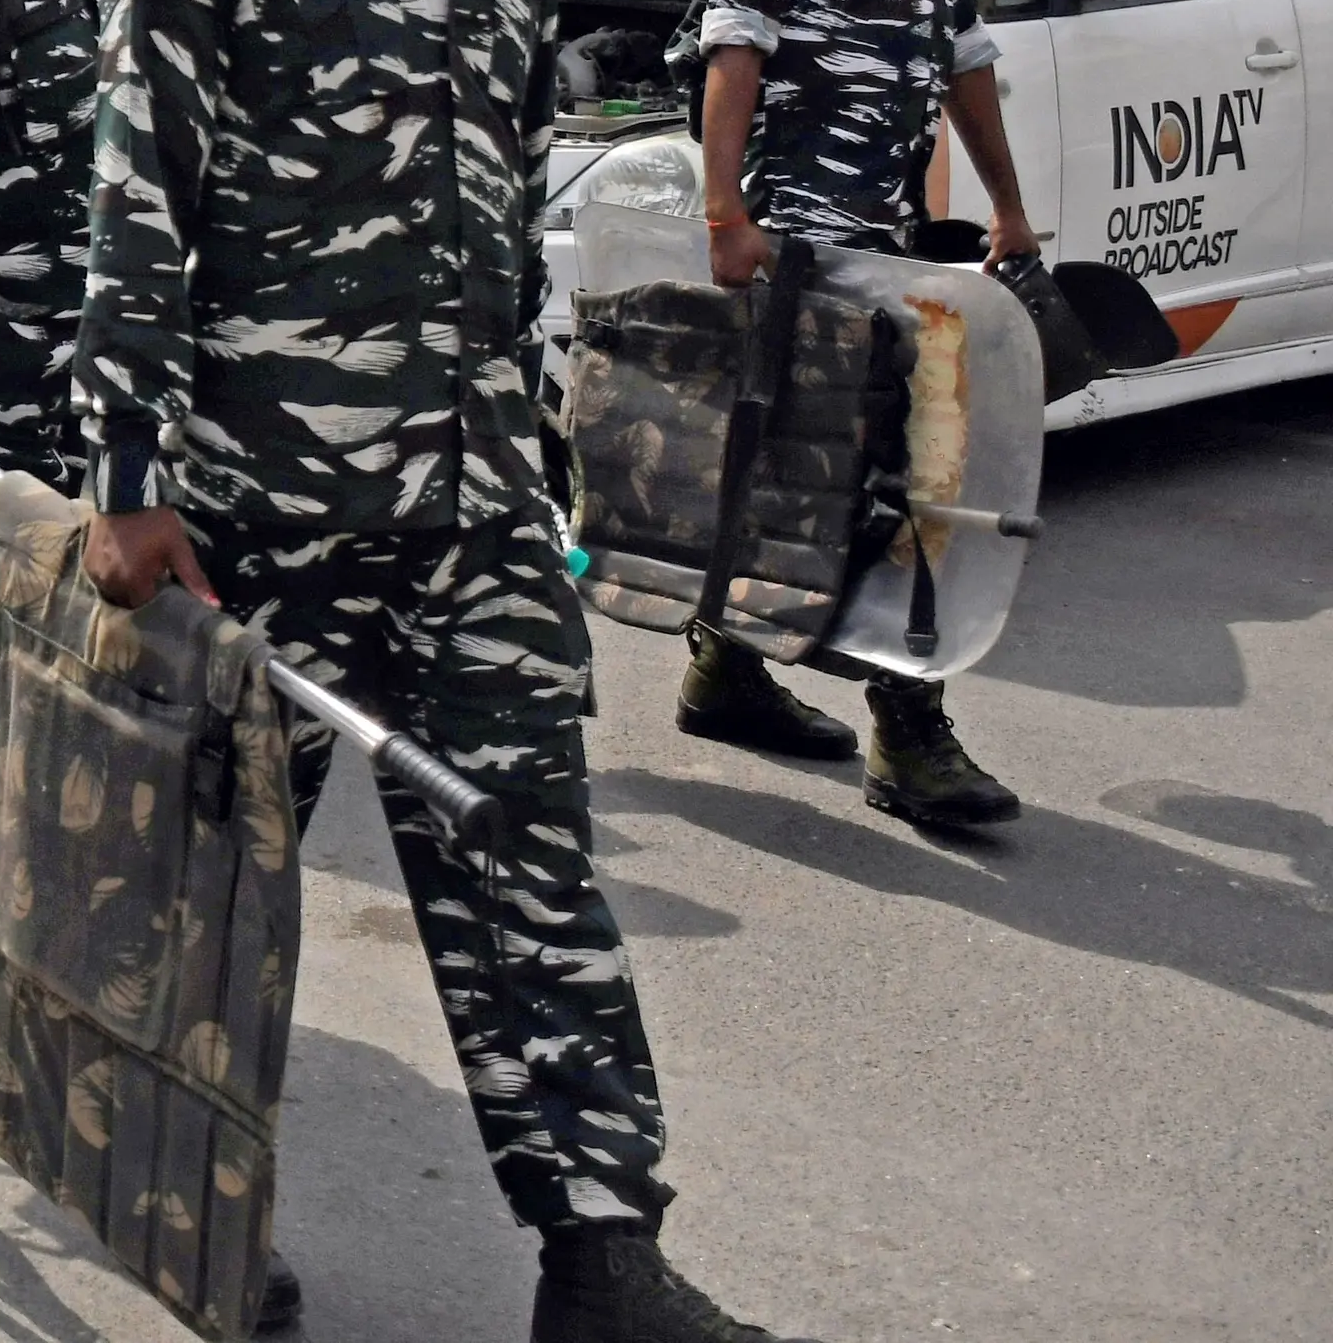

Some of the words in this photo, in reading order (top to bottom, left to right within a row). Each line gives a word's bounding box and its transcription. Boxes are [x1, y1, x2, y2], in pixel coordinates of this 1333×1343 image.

[1110, 93, 1246, 190] INDIA
[1233, 87, 1264, 126] TV
[1107, 195, 1205, 244] OUTSIDE
